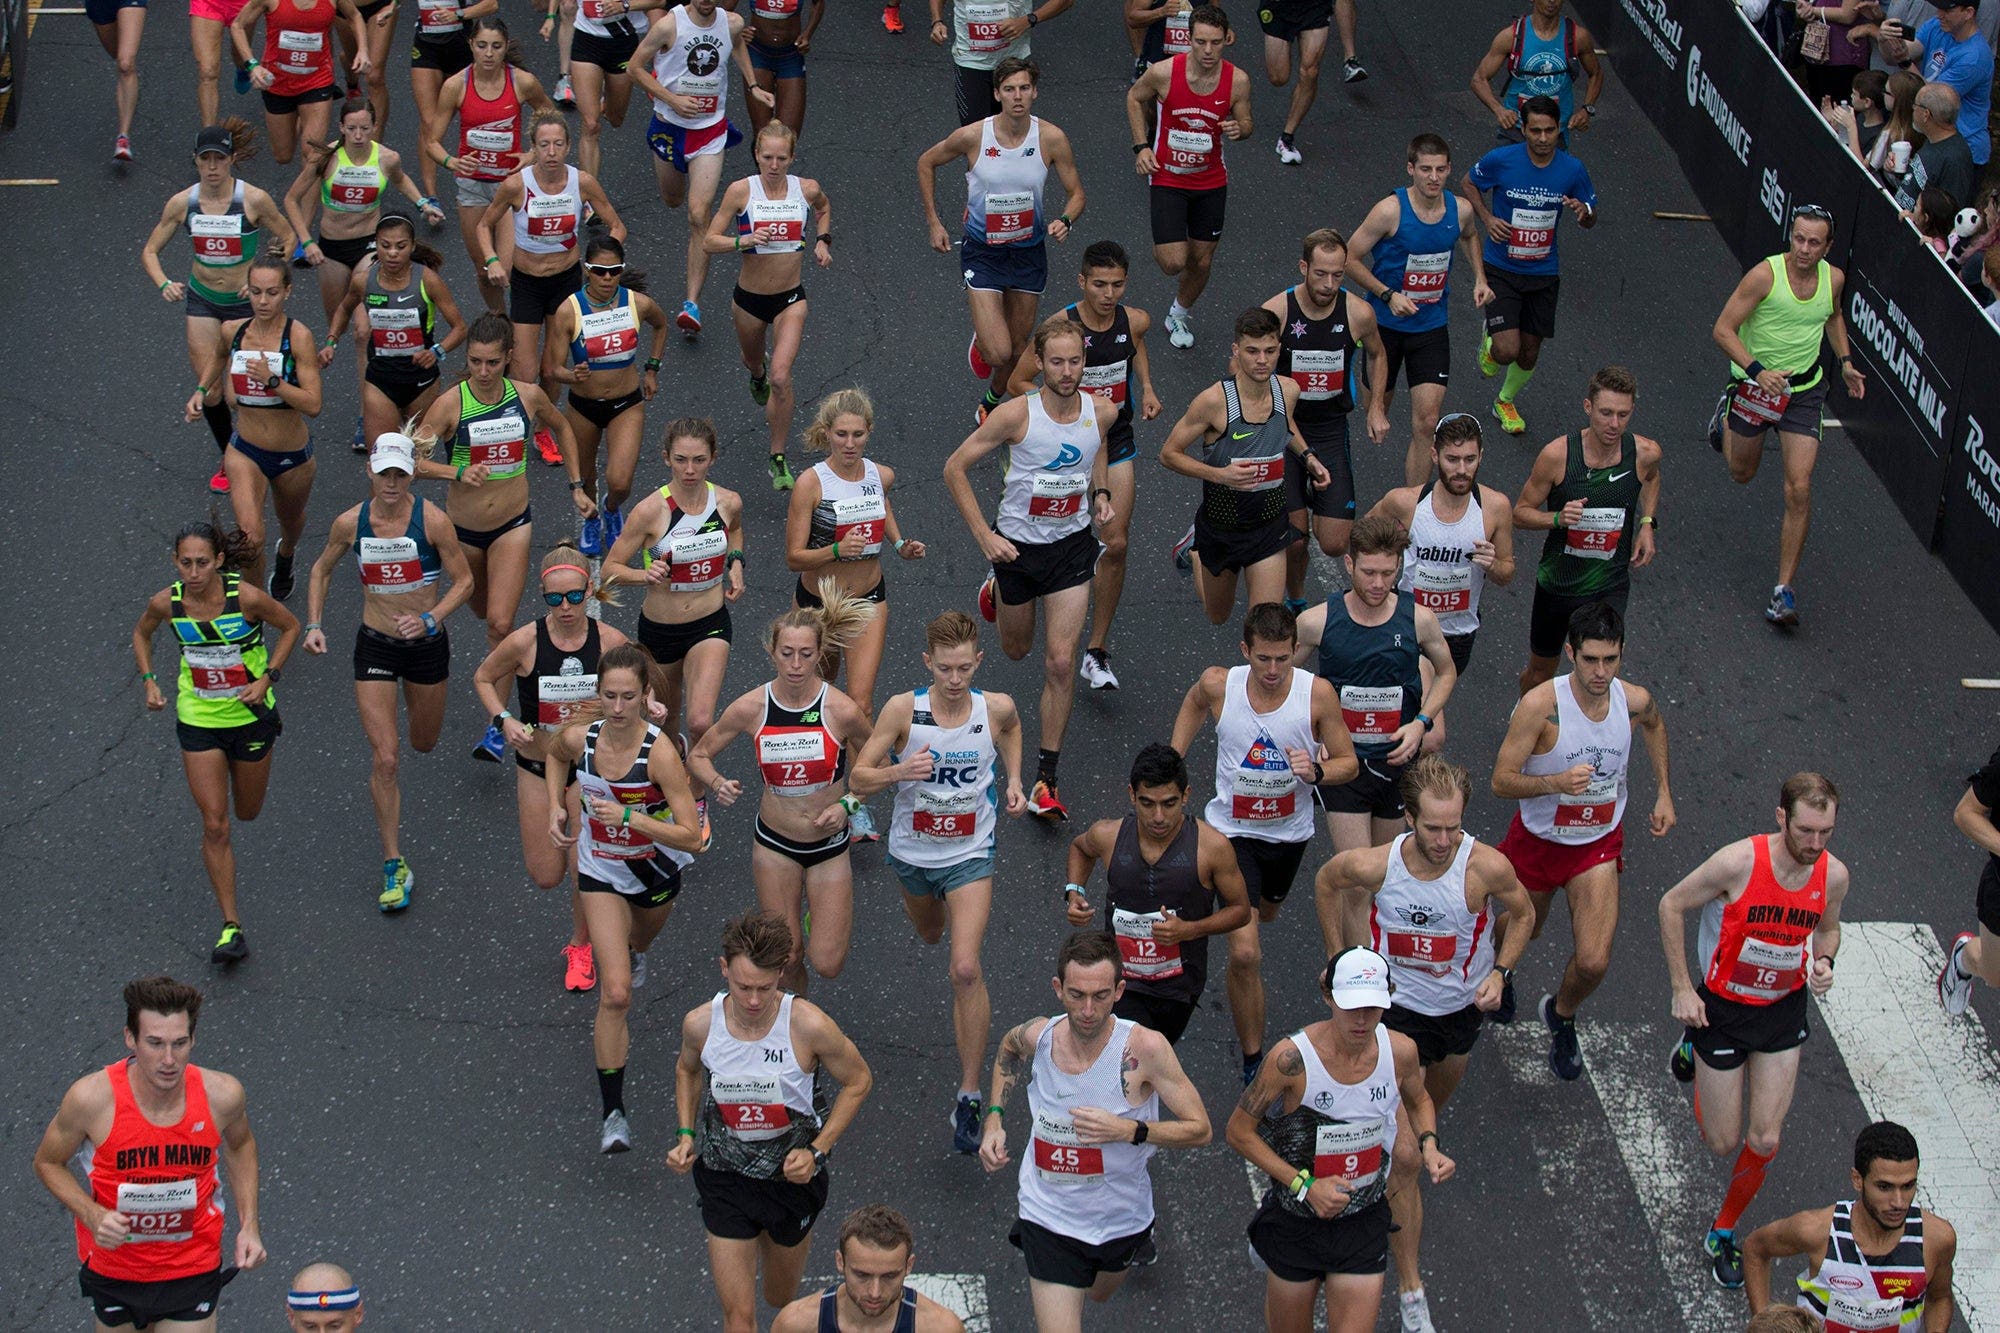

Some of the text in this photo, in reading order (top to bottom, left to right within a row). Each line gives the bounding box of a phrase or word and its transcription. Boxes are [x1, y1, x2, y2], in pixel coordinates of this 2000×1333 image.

[974, 25, 998, 35] 103
[684, 34, 724, 52] OLD GOAT
[290, 52, 308, 62] 88
[1652, 33, 1678, 70] SERIES
[1699, 71, 1752, 167] ENDURANCE
[479, 151, 497, 162] 53
[345, 188, 364, 199] 62
[543, 217, 562, 230] 57
[1002, 214, 1020, 227] 33
[769, 223, 788, 235] 66
[1517, 231, 1547, 242] 1108
[206, 239, 227, 251] 60
[1408, 273, 1445, 287] 9447
[1887, 298, 1924, 356] BUILT WITH
[386, 331, 407, 343] 90
[602, 334, 622, 350] 75
[1852, 291, 1947, 439] CHOCOLATE MILK
[1308, 374, 1328, 386] 32
[487, 445, 510, 458] 56
[1047, 499, 1069, 512] 27
[1583, 533, 1606, 545] 43
[1416, 546, 1463, 564] rabbit
[380, 565, 403, 579] 52
[689, 561, 712, 575] 96
[1421, 593, 1461, 607] 1015
[207, 671, 226, 684] 51
[1364, 713, 1376, 727] 5
[763, 737, 820, 750] Rock Roll
[945, 751, 979, 759] PACERS
[1251, 748, 1279, 760] CSTC
[781, 764, 807, 780] 72
[1263, 762, 1284, 770] ELITE
[1251, 800, 1279, 812] 44
[1247, 811, 1282, 820] WILLIAMS
[1582, 807, 1594, 820] 8
[931, 816, 956, 831] 36
[605, 826, 632, 840] 94
[1409, 903, 1434, 913] TRACK
[1746, 905, 1784, 924] BRYN
[1136, 941, 1157, 958] 12
[1411, 936, 1432, 954] 13
[1129, 955, 1167, 965] GUERRERO
[1756, 968, 1778, 984] 16
[715, 1079, 775, 1090] Rock Roll
[738, 1105, 765, 1122] 23
[735, 1122, 774, 1130] LEININGER
[116, 1146, 159, 1170] BRYN
[1049, 1147, 1080, 1166] 45
[1344, 1154, 1359, 1172] 9
[1051, 1164, 1080, 1174] WYATT
[128, 1212, 182, 1230] 1012
[1832, 1278, 1860, 1288] HANSONS
[1883, 1278, 1912, 1287] BROOKS
[1834, 1300, 1900, 1317] Rock Roll
